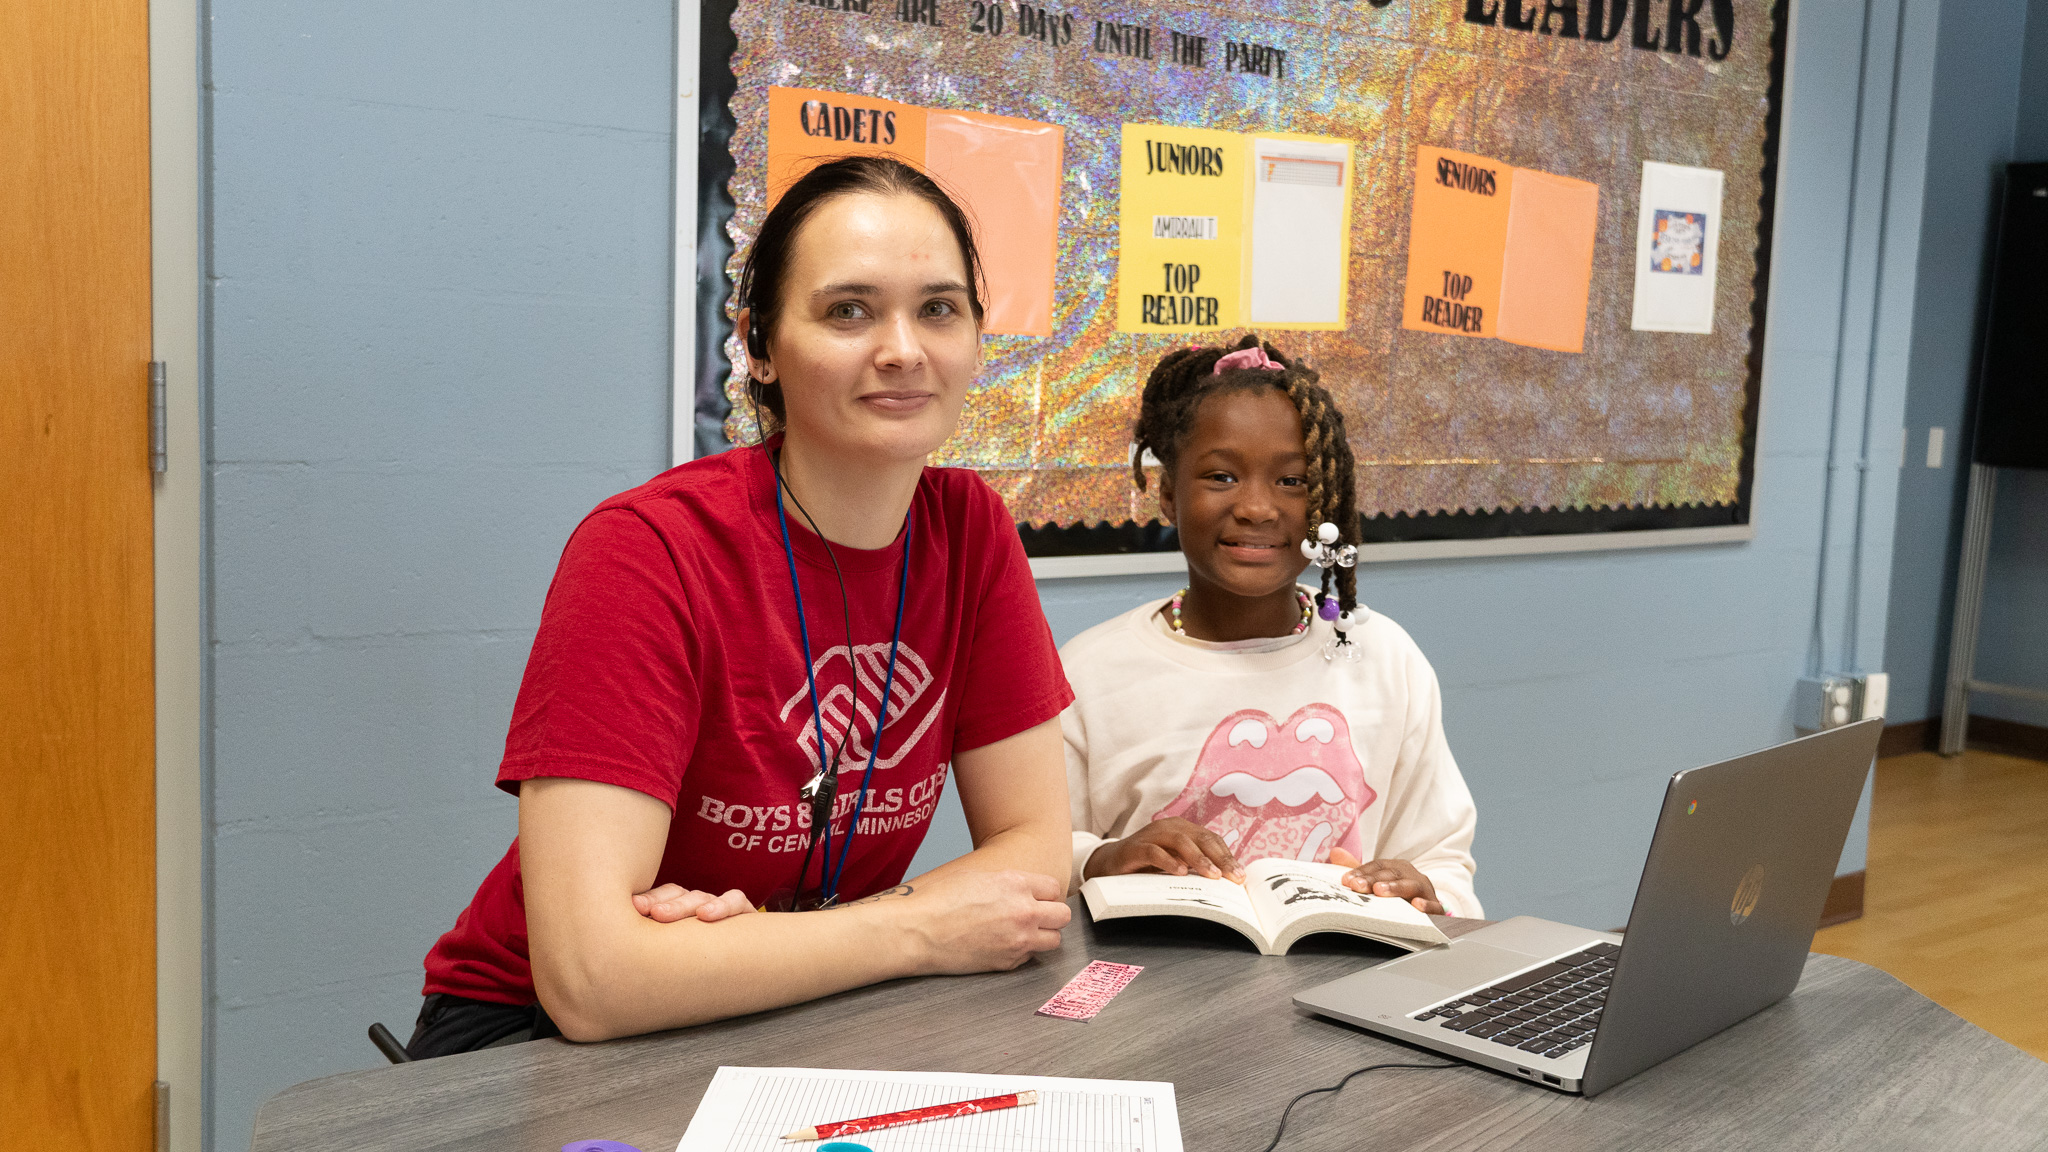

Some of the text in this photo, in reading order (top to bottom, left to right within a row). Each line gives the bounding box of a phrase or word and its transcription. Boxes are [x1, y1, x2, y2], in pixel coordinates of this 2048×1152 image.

[797, 0, 1286, 79] ERE ARE 20 DAYS UNTIL THE PARTY
[1465, 0, 1734, 61] DERS
[800, 101, 897, 145] CADETS
[1146, 139, 1224, 177] JUNIORS
[1436, 157, 1497, 197] SENIORS
[1164, 263, 1200, 293] TOP
[1442, 270, 1473, 301] TOP
[1142, 294, 1219, 326] READER
[1421, 295, 1483, 333] READER
[697, 795, 792, 832] BOYS
[797, 803, 814, 829] &
[728, 832, 763, 852] OF
